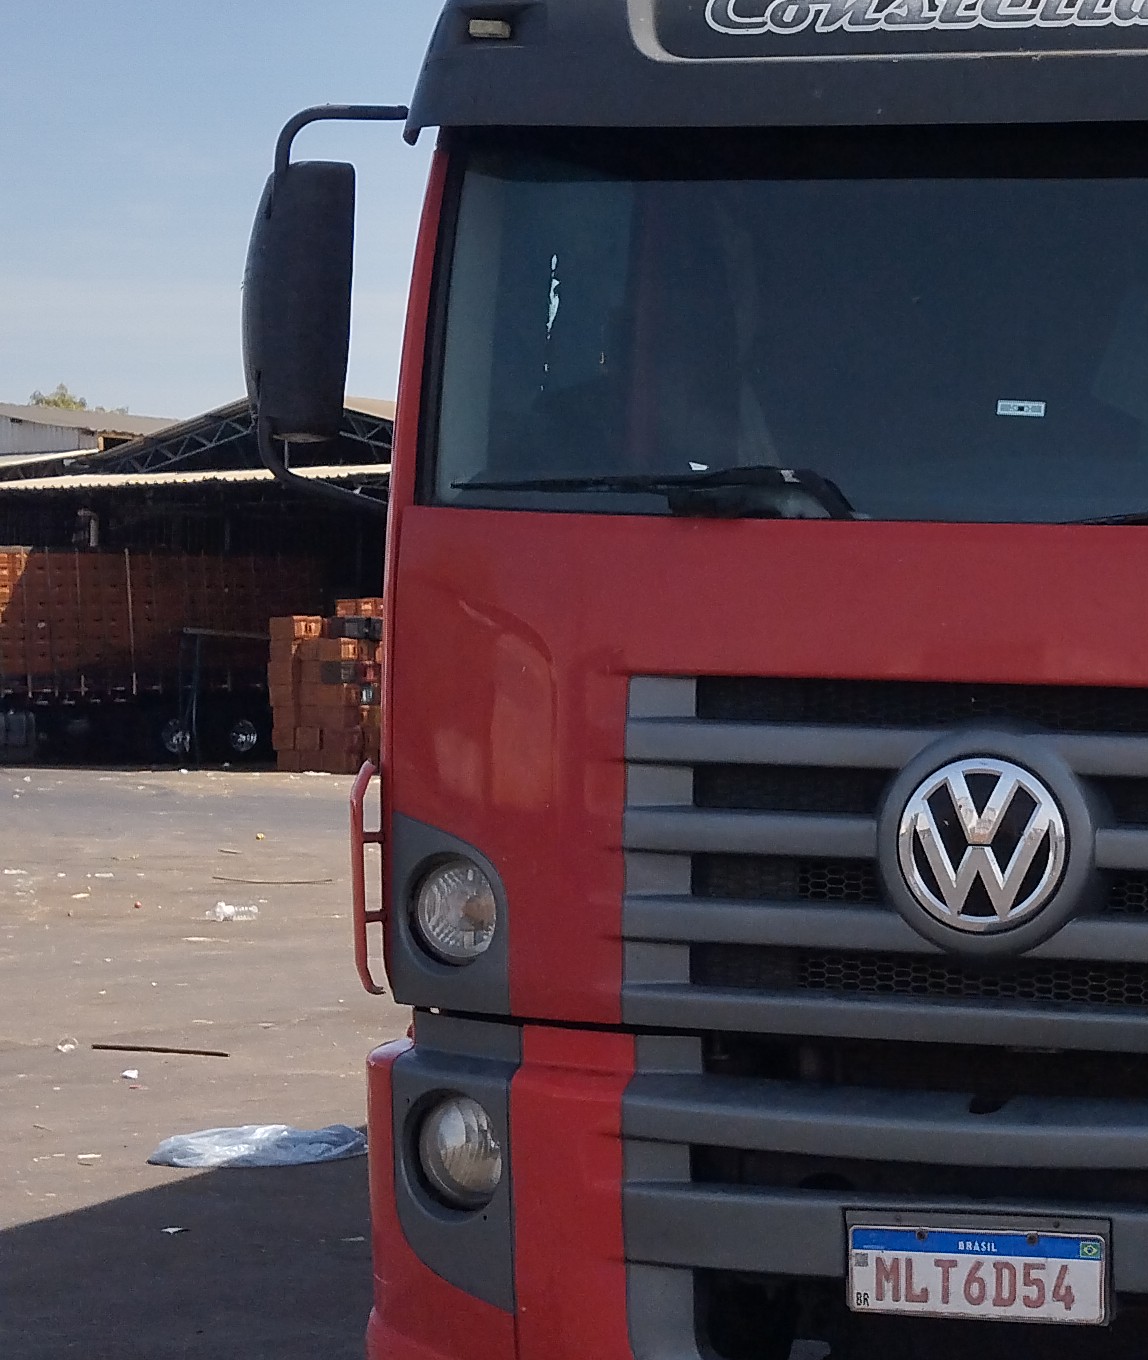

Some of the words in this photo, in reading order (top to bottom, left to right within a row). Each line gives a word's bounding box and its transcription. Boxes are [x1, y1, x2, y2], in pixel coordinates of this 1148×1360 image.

[899, 758, 1066, 932] VW
[957, 1240, 998, 1253] BRASIL
[855, 1291, 870, 1307] BR
[874, 1256, 1076, 1311] MLT6D54
